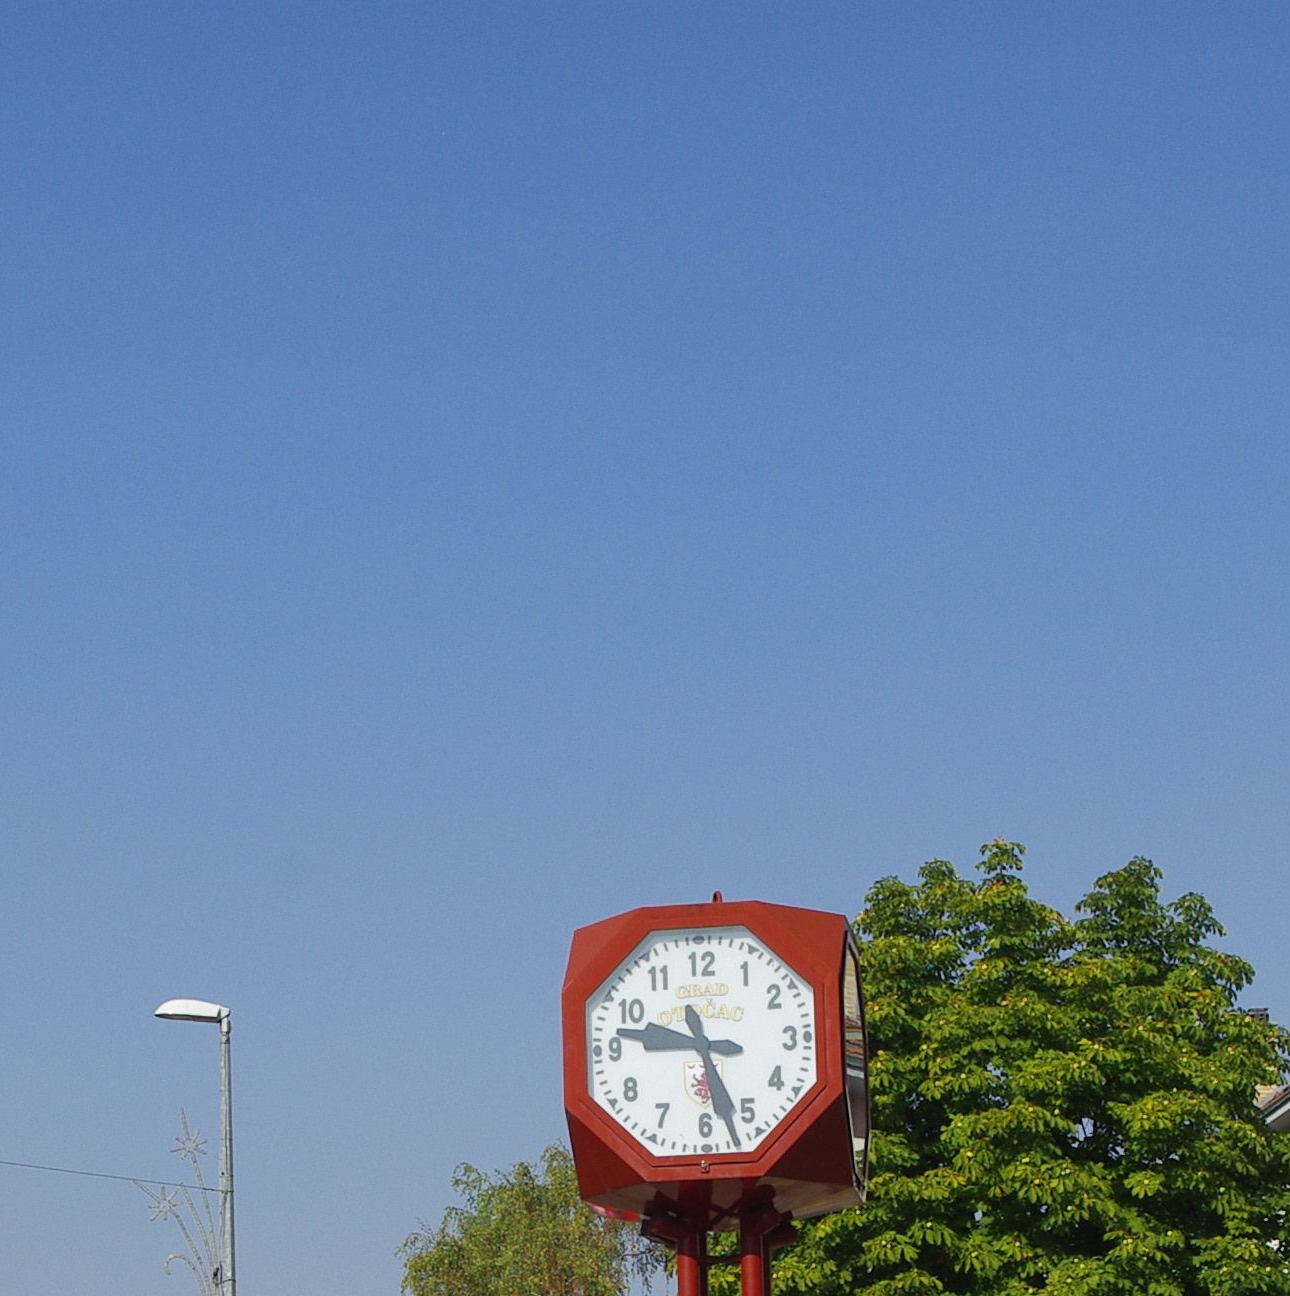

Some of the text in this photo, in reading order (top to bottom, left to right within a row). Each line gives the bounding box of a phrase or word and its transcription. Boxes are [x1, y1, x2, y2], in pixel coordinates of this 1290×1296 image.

[688, 951, 716, 977] 12
[740, 961, 749, 986] 1
[648, 965, 669, 991] 11
[676, 982, 729, 999] GRAD
[766, 984, 782, 1010] 2
[618, 998, 645, 1024] 10
[608, 1036, 622, 1062] 9
[782, 1025, 798, 1051] 3
[623, 1077, 638, 1102] 8
[767, 1065, 785, 1091] 4
[655, 1102, 670, 1129] 7
[740, 1097, 756, 1124] 5
[698, 1112, 713, 1139] 6
